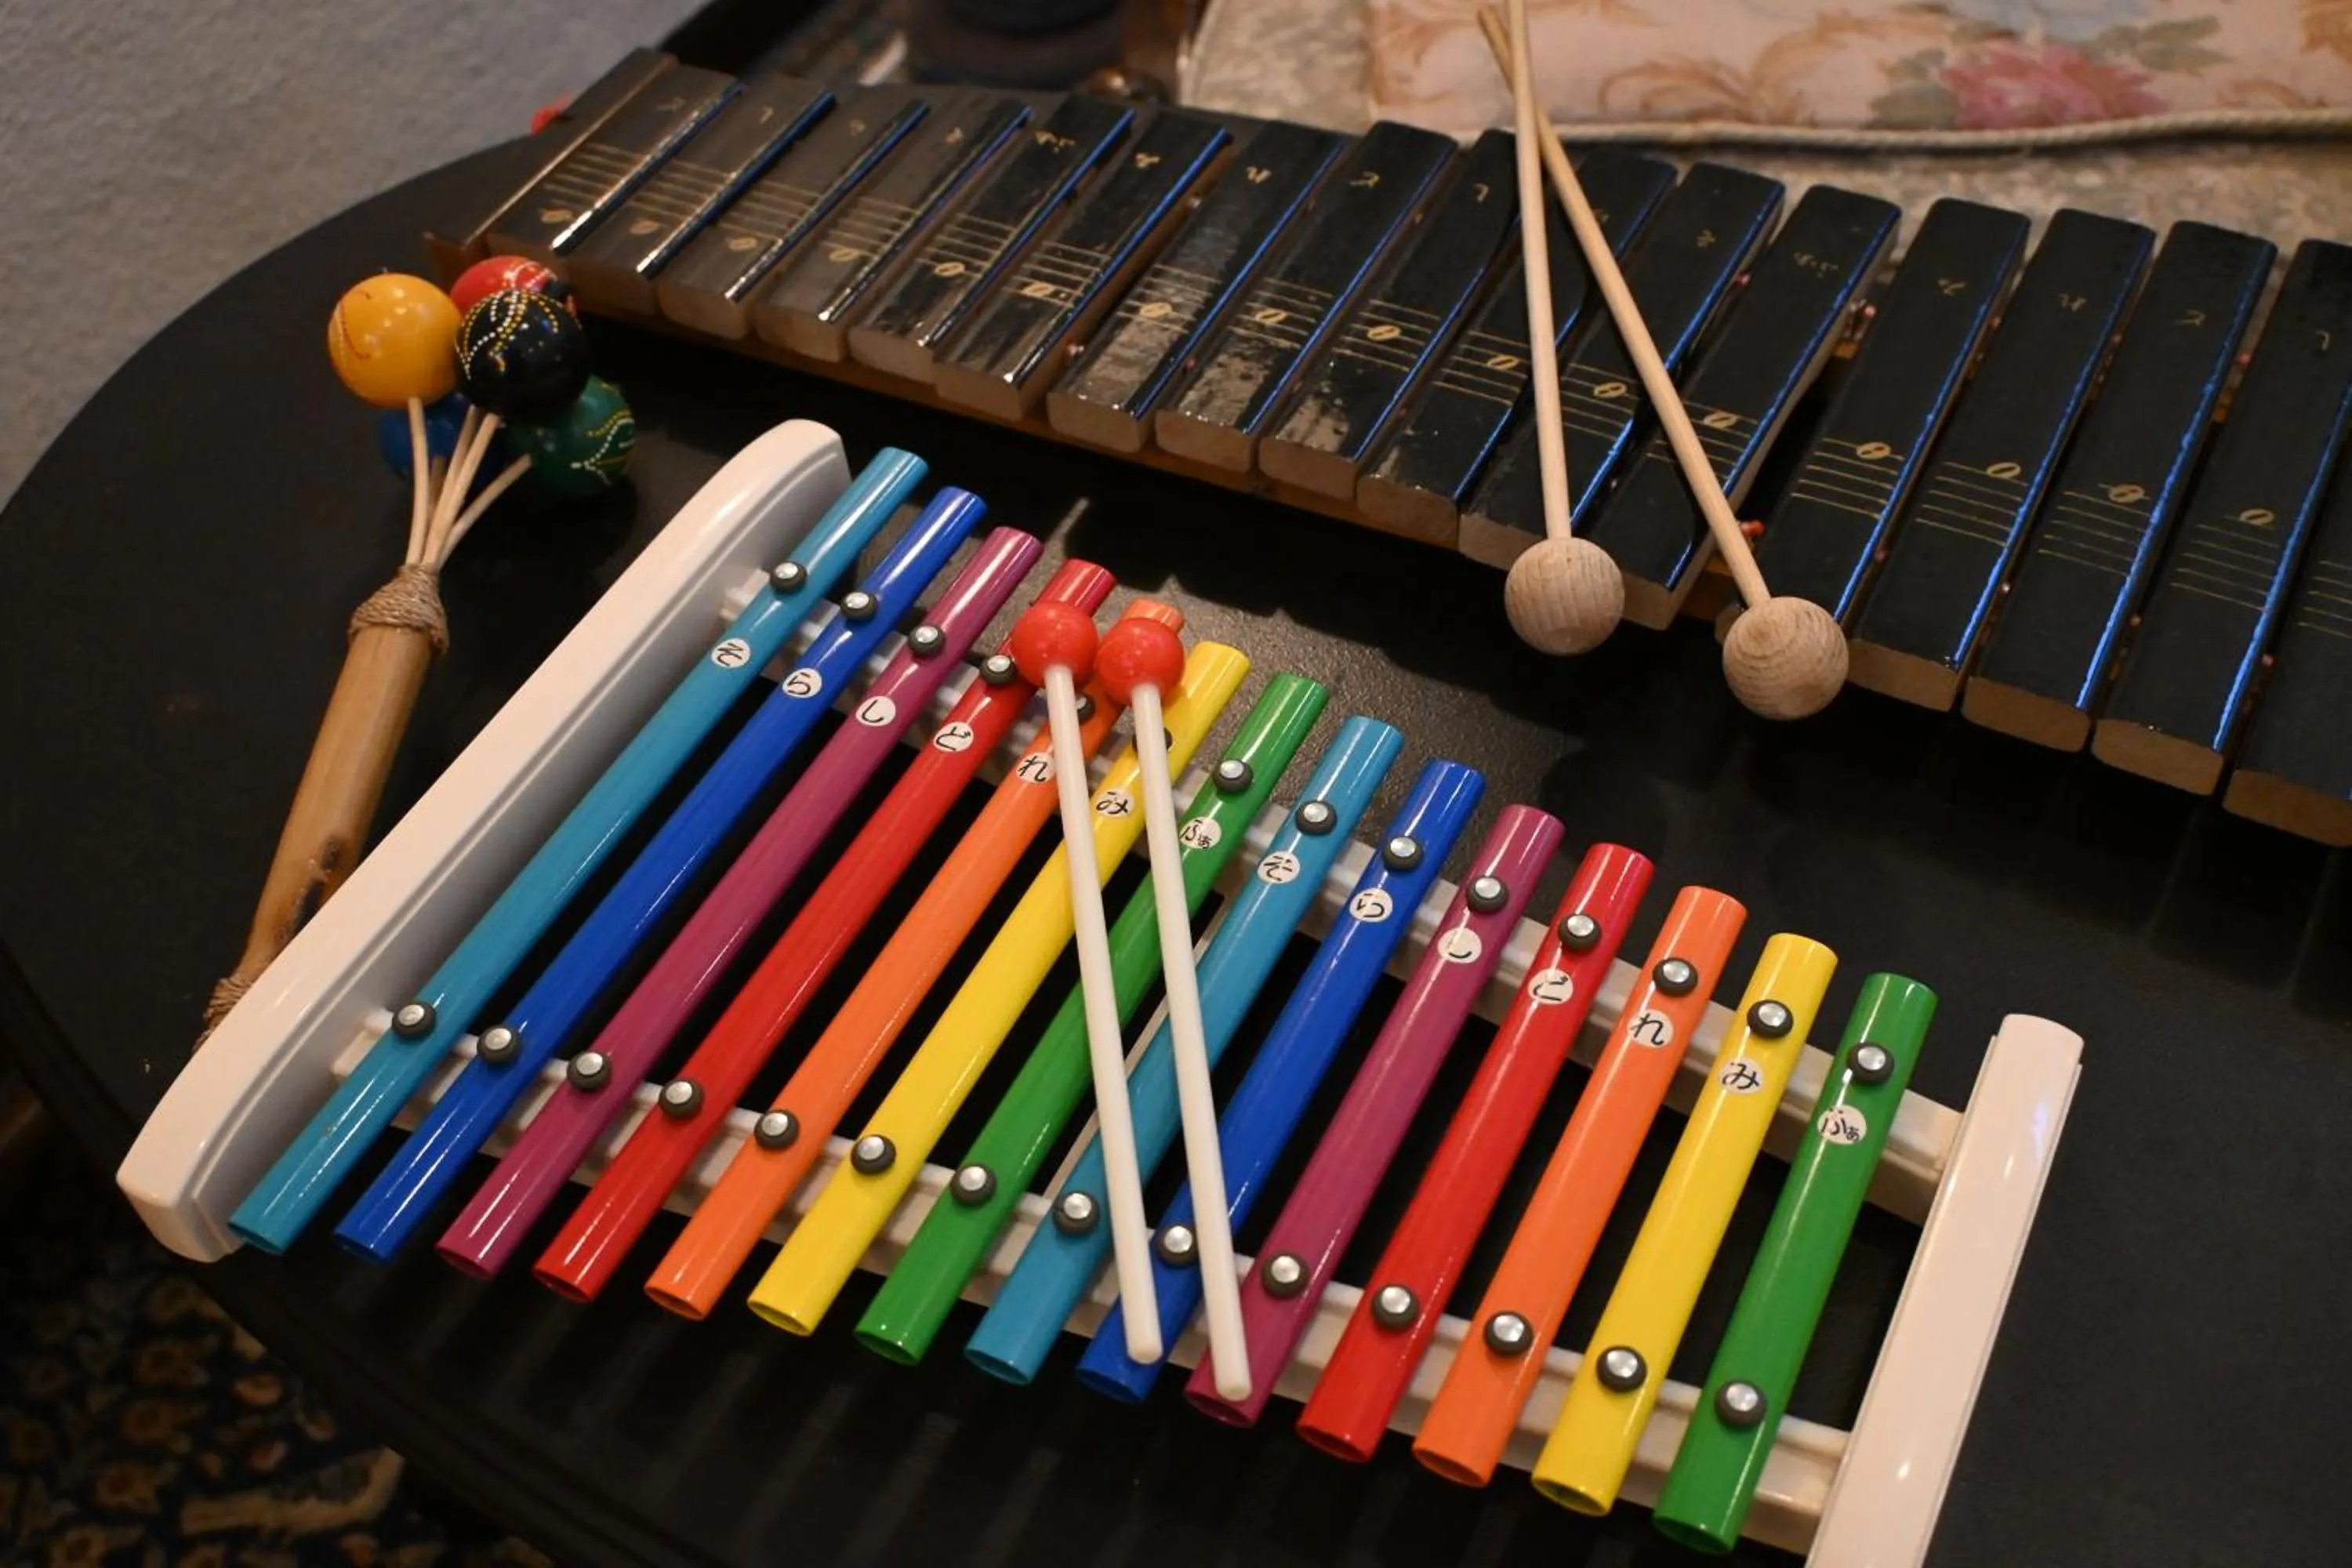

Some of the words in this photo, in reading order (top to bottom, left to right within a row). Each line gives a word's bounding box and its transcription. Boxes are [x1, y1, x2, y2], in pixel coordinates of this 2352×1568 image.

[717, 642, 742, 666] そ
[788, 672, 811, 695] ら
[862, 699, 884, 723] し
[935, 726, 971, 751] ど
[1019, 755, 1047, 782] れ
[1096, 792, 1129, 814] み
[1357, 894, 1385, 917] ら
[1631, 1013, 1664, 1045] れ
[1722, 1062, 1760, 1089] み
